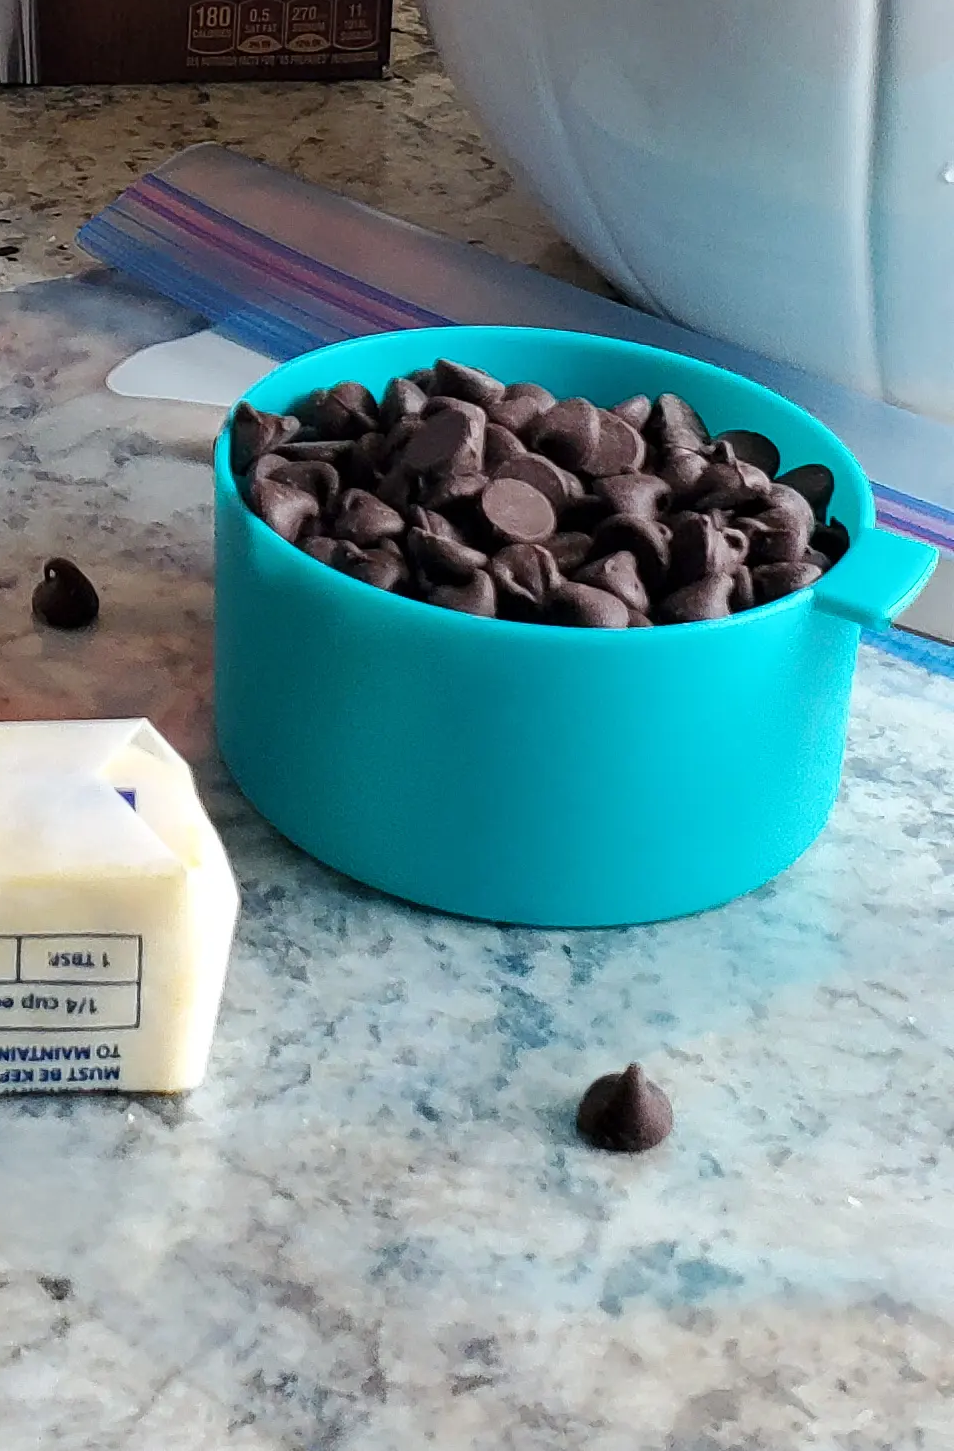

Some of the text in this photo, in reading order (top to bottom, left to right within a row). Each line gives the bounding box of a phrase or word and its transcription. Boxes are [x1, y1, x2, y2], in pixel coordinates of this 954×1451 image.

[196, 6, 232, 28] 180
[21, 994, 59, 1011] cup
[65, 996, 98, 1014] 1/4
[96, 1043, 121, 1059] TO
[39, 1067, 62, 1083] BE
[67, 1065, 121, 1082] MUST
